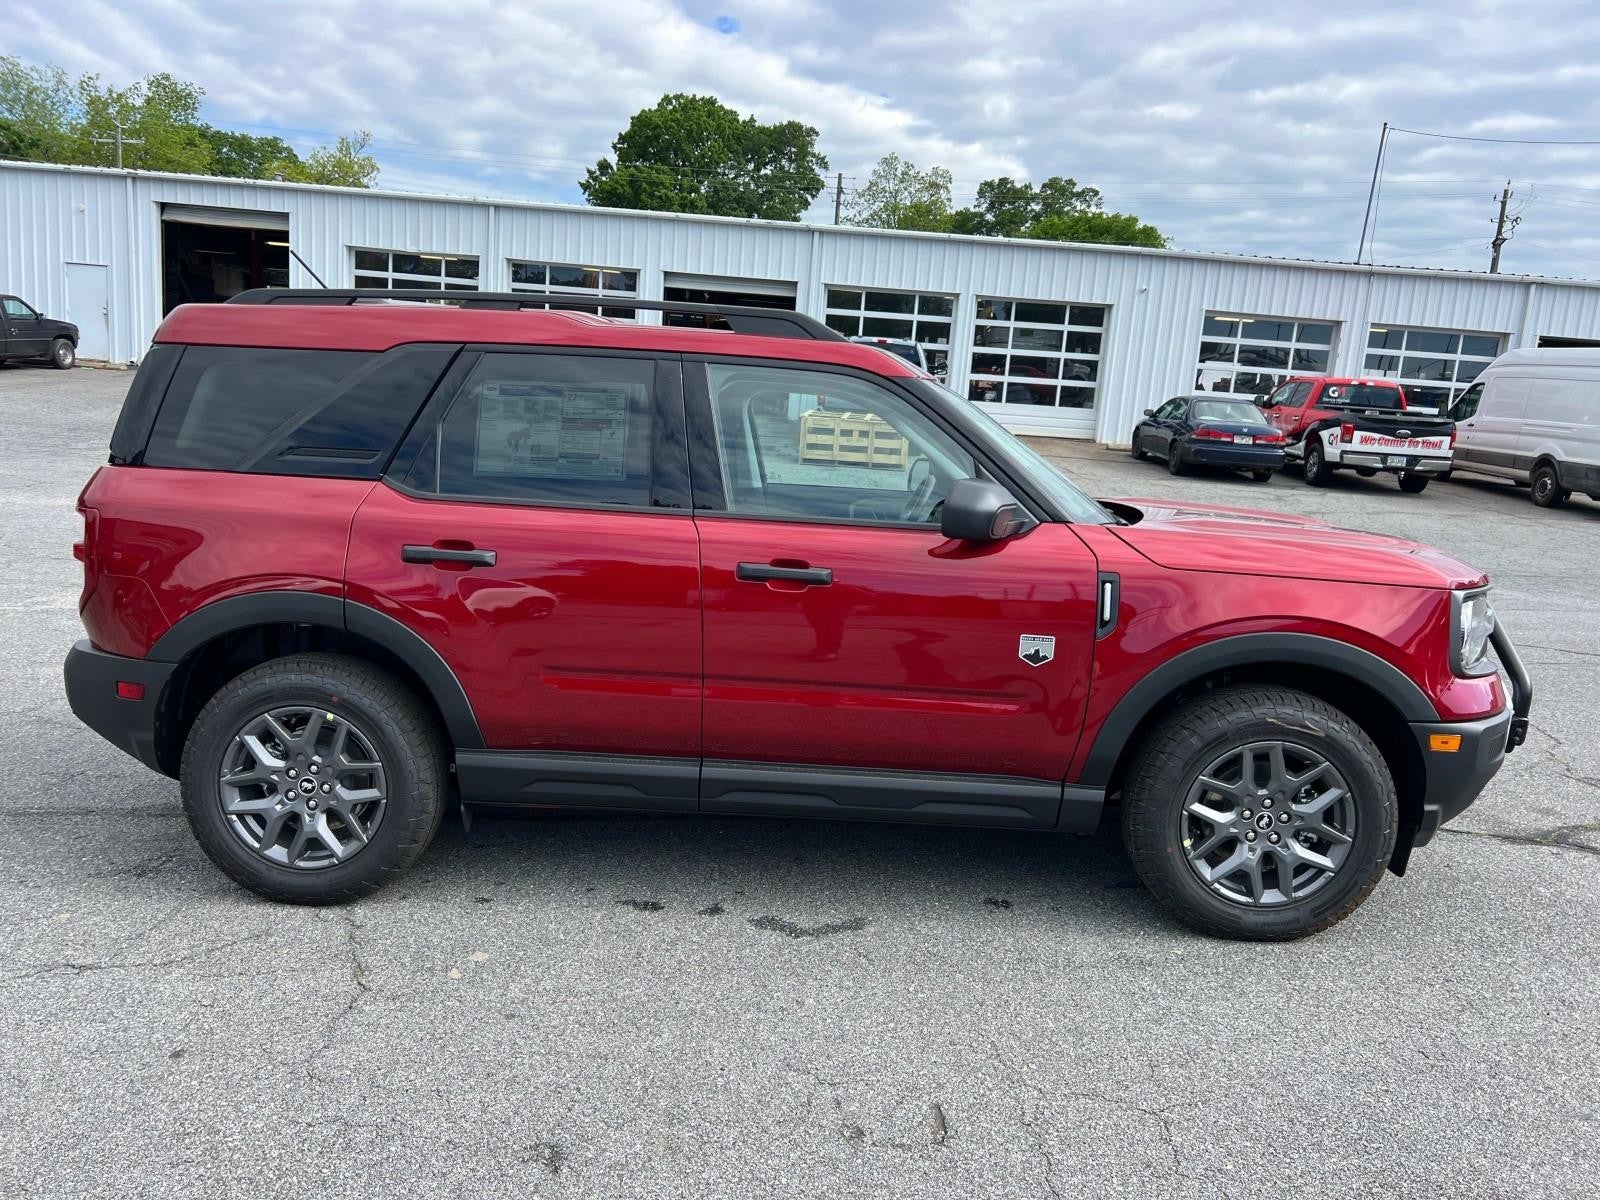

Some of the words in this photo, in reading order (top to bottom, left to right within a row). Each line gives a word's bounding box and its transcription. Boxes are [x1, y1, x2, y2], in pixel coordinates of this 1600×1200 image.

[1359, 435, 1376, 446] We
[1377, 436, 1406, 448] Come
[1421, 439, 1443, 450] You!
